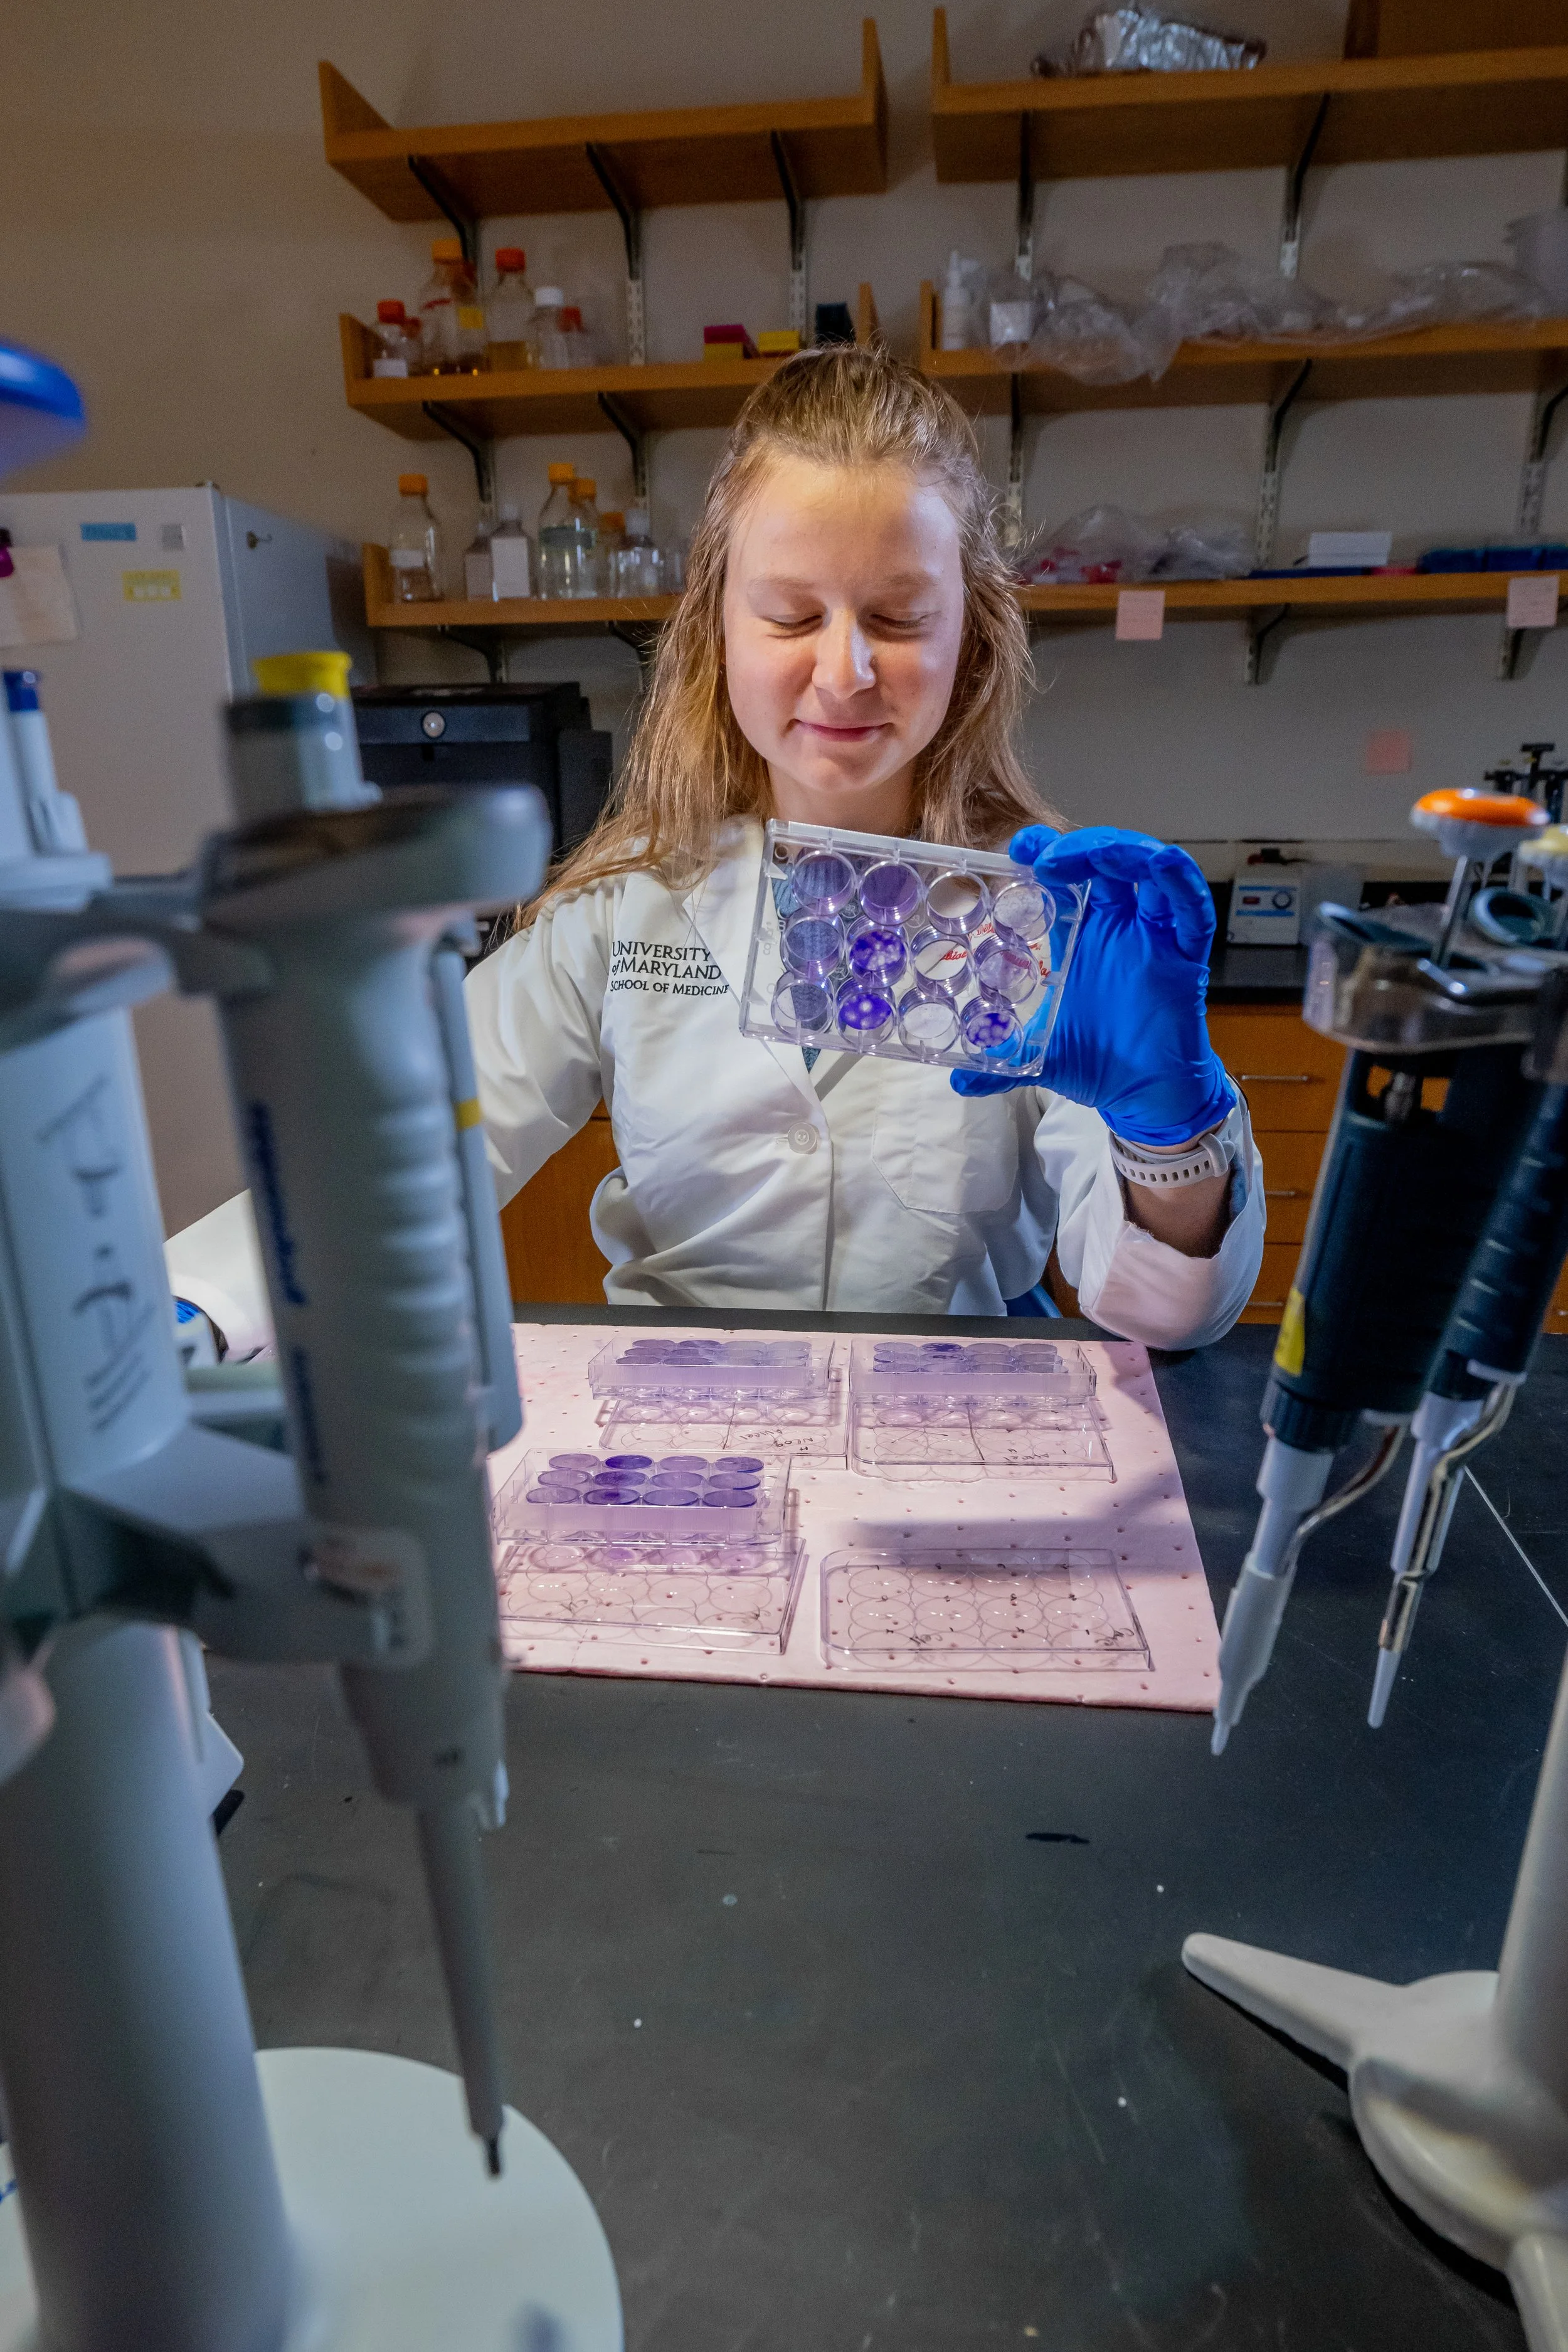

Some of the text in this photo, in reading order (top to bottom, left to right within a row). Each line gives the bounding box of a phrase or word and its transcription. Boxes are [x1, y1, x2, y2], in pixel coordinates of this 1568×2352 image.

[612, 940, 711, 962] UNIVERSITY
[612, 956, 722, 980] of MARYLAND
[610, 979, 730, 996] SCHOOL OF MEDICINE
